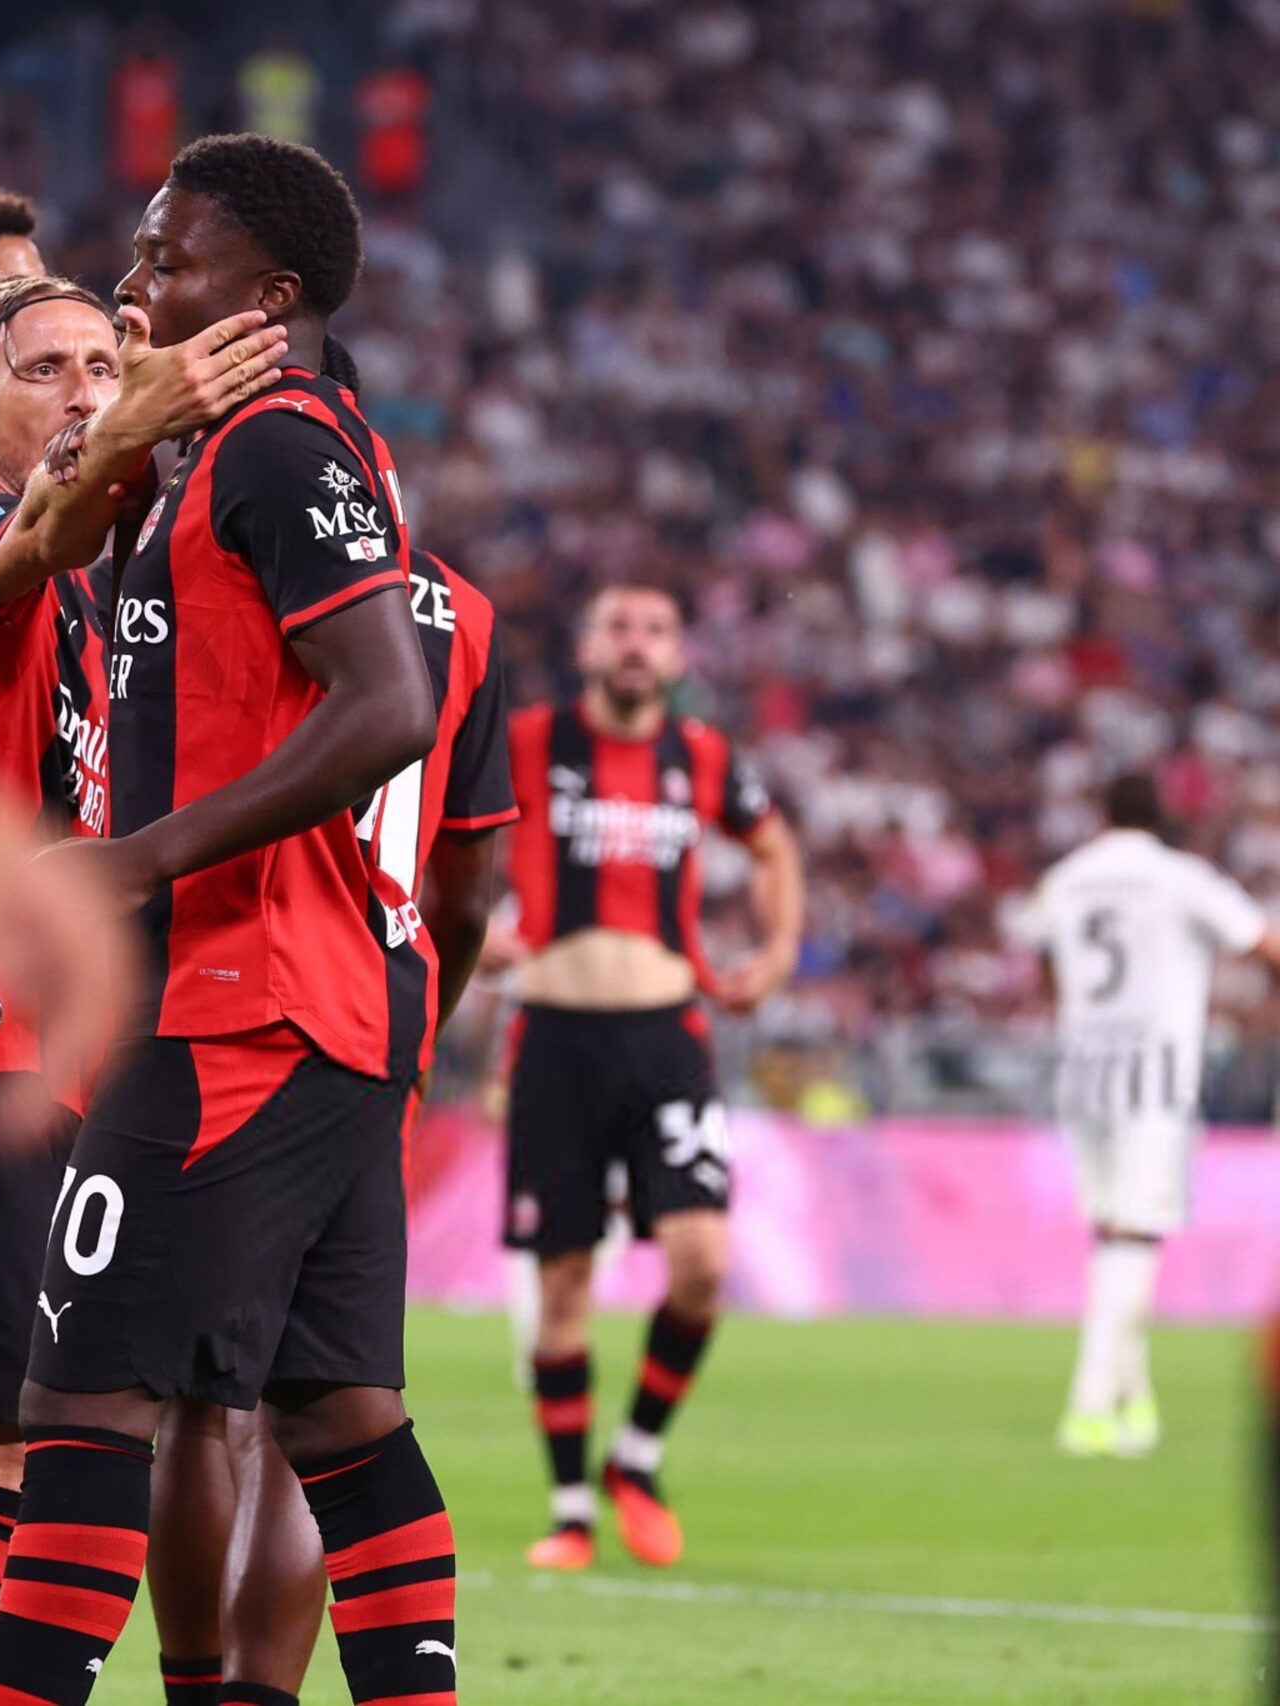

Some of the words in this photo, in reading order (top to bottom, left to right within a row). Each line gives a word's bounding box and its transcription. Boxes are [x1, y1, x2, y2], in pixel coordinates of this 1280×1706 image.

[305, 502, 388, 540] MSC
[358, 537, 376, 561] 6
[1082, 907, 1127, 1006] 5
[48, 1165, 125, 1276] 70
